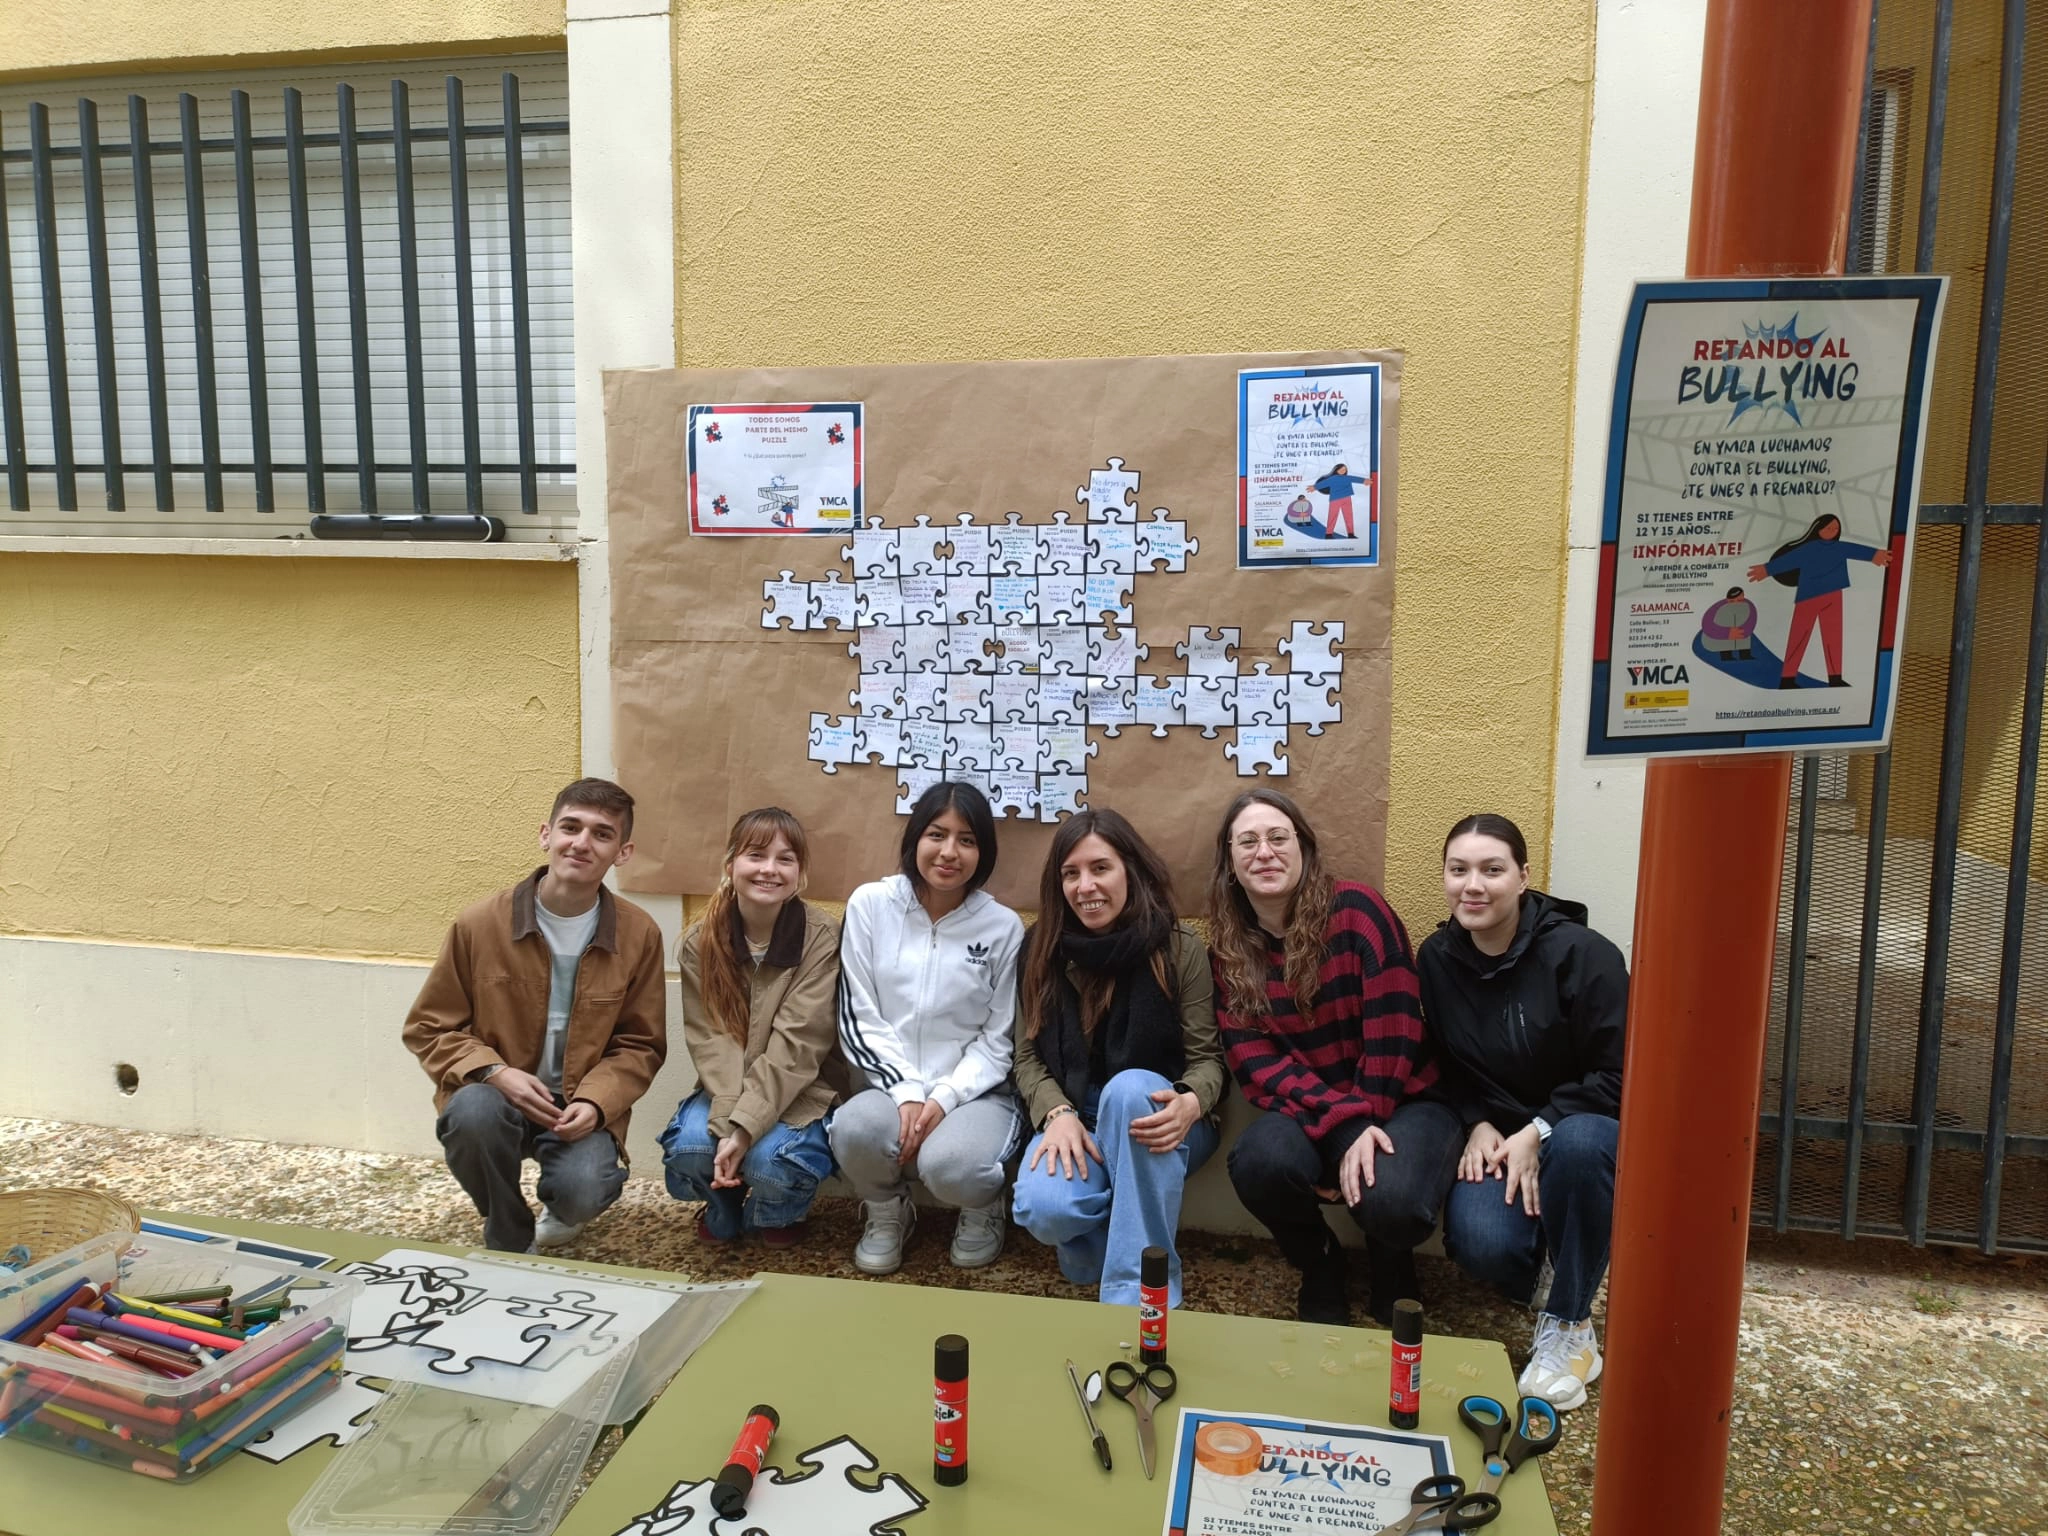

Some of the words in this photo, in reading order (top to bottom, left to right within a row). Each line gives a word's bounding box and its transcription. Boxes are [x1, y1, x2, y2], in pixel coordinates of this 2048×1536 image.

[1694, 338, 1813, 362] RETANDO
[1821, 338, 1850, 360] AL
[1678, 361, 1859, 405] BULLYING
[1273, 391, 1328, 402] RETANDO
[1331, 390, 1344, 400] AL
[1268, 401, 1348, 420] BULLYING
[1694, 439, 1711, 455] EN
[1715, 438, 1755, 455] YMCA
[1761, 437, 1833, 453] LUCHAMOS
[1690, 460, 1742, 477] CONTRA
[1747, 461, 1762, 476] EL
[1681, 484, 1707, 499] ¿TE
[1710, 483, 1745, 499] UNES
[1750, 484, 1759, 496] A
[1763, 480, 1836, 496] FRENARLO?
[819, 496, 848, 507] YMCA
[1637, 511, 1650, 524] SI
[1653, 510, 1694, 523] TIENES
[1697, 509, 1734, 522] ENTRE
[1254, 528, 1284, 537] YMCA
[1635, 525, 1648, 537] 12
[1651, 525, 1659, 536] Y
[1662, 524, 1674, 536] 15
[1676, 522, 1720, 536] AÑOS...
[1632, 539, 1743, 560] ¡INFÓRMATE!
[1648, 564, 1682, 572] APRENDE
[1690, 563, 1730, 571] COMBATIR
[1662, 572, 1670, 580] EL
[1672, 571, 1708, 579] BULLYING
[1630, 602, 1690, 613] SALAMANCA
[1626, 665, 1690, 686] YMCA
[1715, 706, 1841, 720] https://retandoalbullying.ymca.es/
[965, 957, 987, 966] adidas
[1401, 1352, 1417, 1361] MP
[935, 1407, 955, 1420] tick
[1262, 1444, 1348, 1462] ETANDO
[1354, 1454, 1381, 1467] AL
[1259, 1455, 1391, 1487] ULLYING
[1250, 1498, 1296, 1511] CONTRA
[1300, 1503, 1314, 1513] EL
[1252, 1487, 1267, 1497] EN
[1271, 1490, 1306, 1501] YMCA
[1311, 1494, 1376, 1510] LUCHAMOS
[1243, 1508, 1264, 1518] ¿TE
[1269, 1511, 1301, 1524] UNES
[1305, 1515, 1313, 1524] A
[1202, 1523, 1215, 1531] 12
[1227, 1526, 1239, 1534] 15
[1203, 1516, 1215, 1524] SI
[1218, 1518, 1255, 1529] TIENES
[1258, 1523, 1293, 1533] ENTRE
